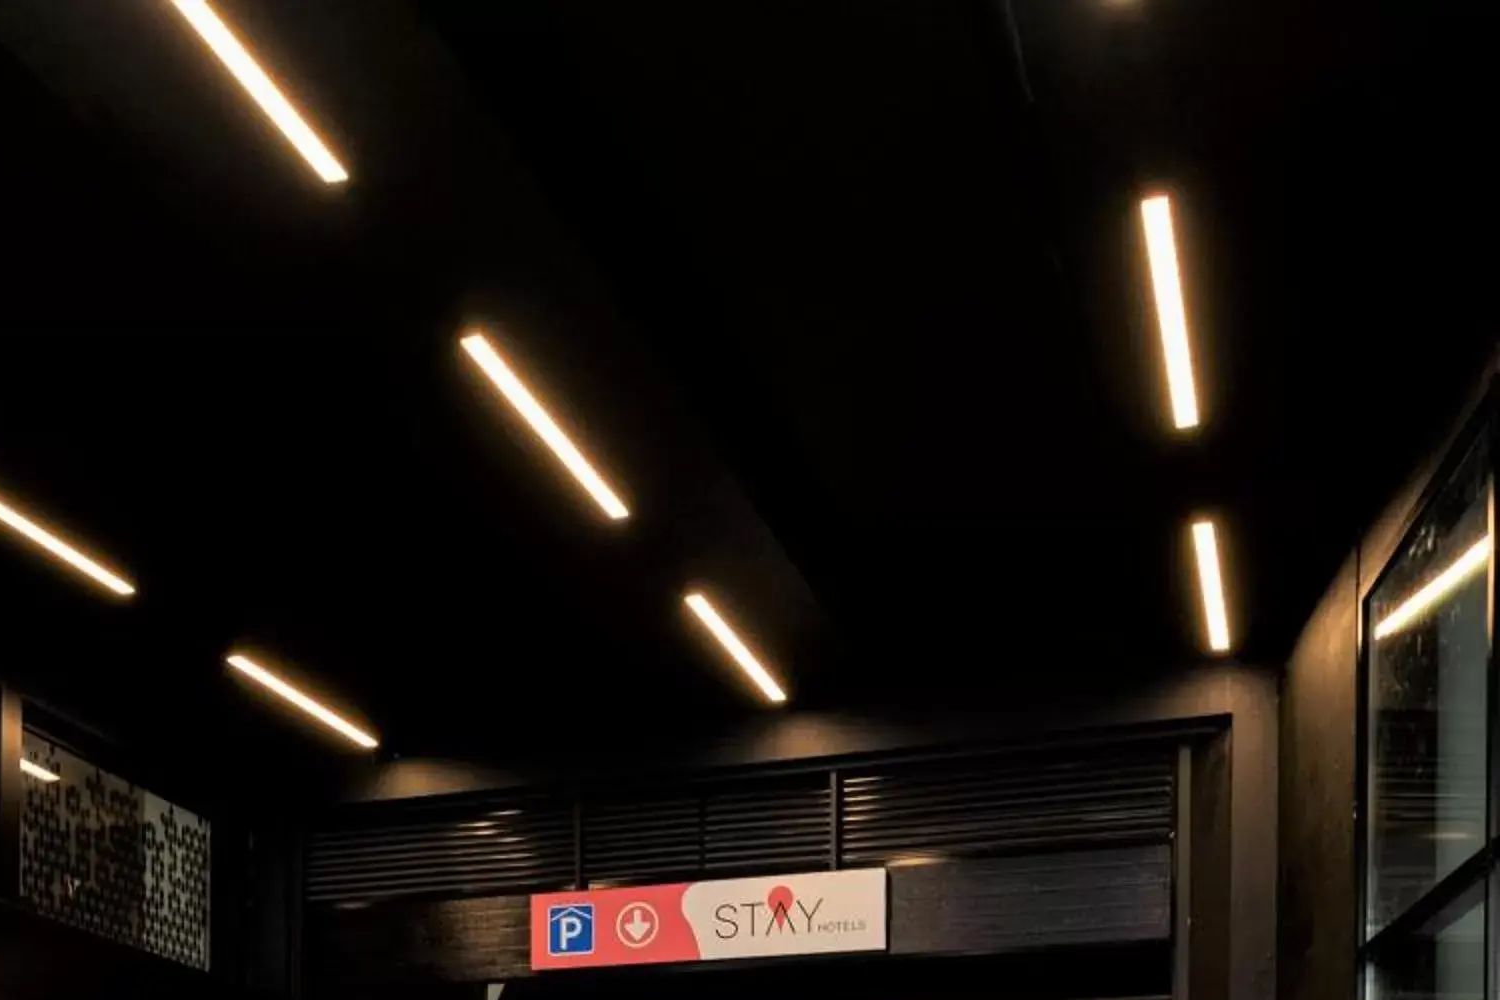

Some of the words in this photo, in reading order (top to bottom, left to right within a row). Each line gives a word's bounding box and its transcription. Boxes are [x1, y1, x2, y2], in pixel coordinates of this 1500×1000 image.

[560, 916, 582, 951] P
[715, 898, 822, 939] STAY
[818, 920, 867, 934] HOTELS
